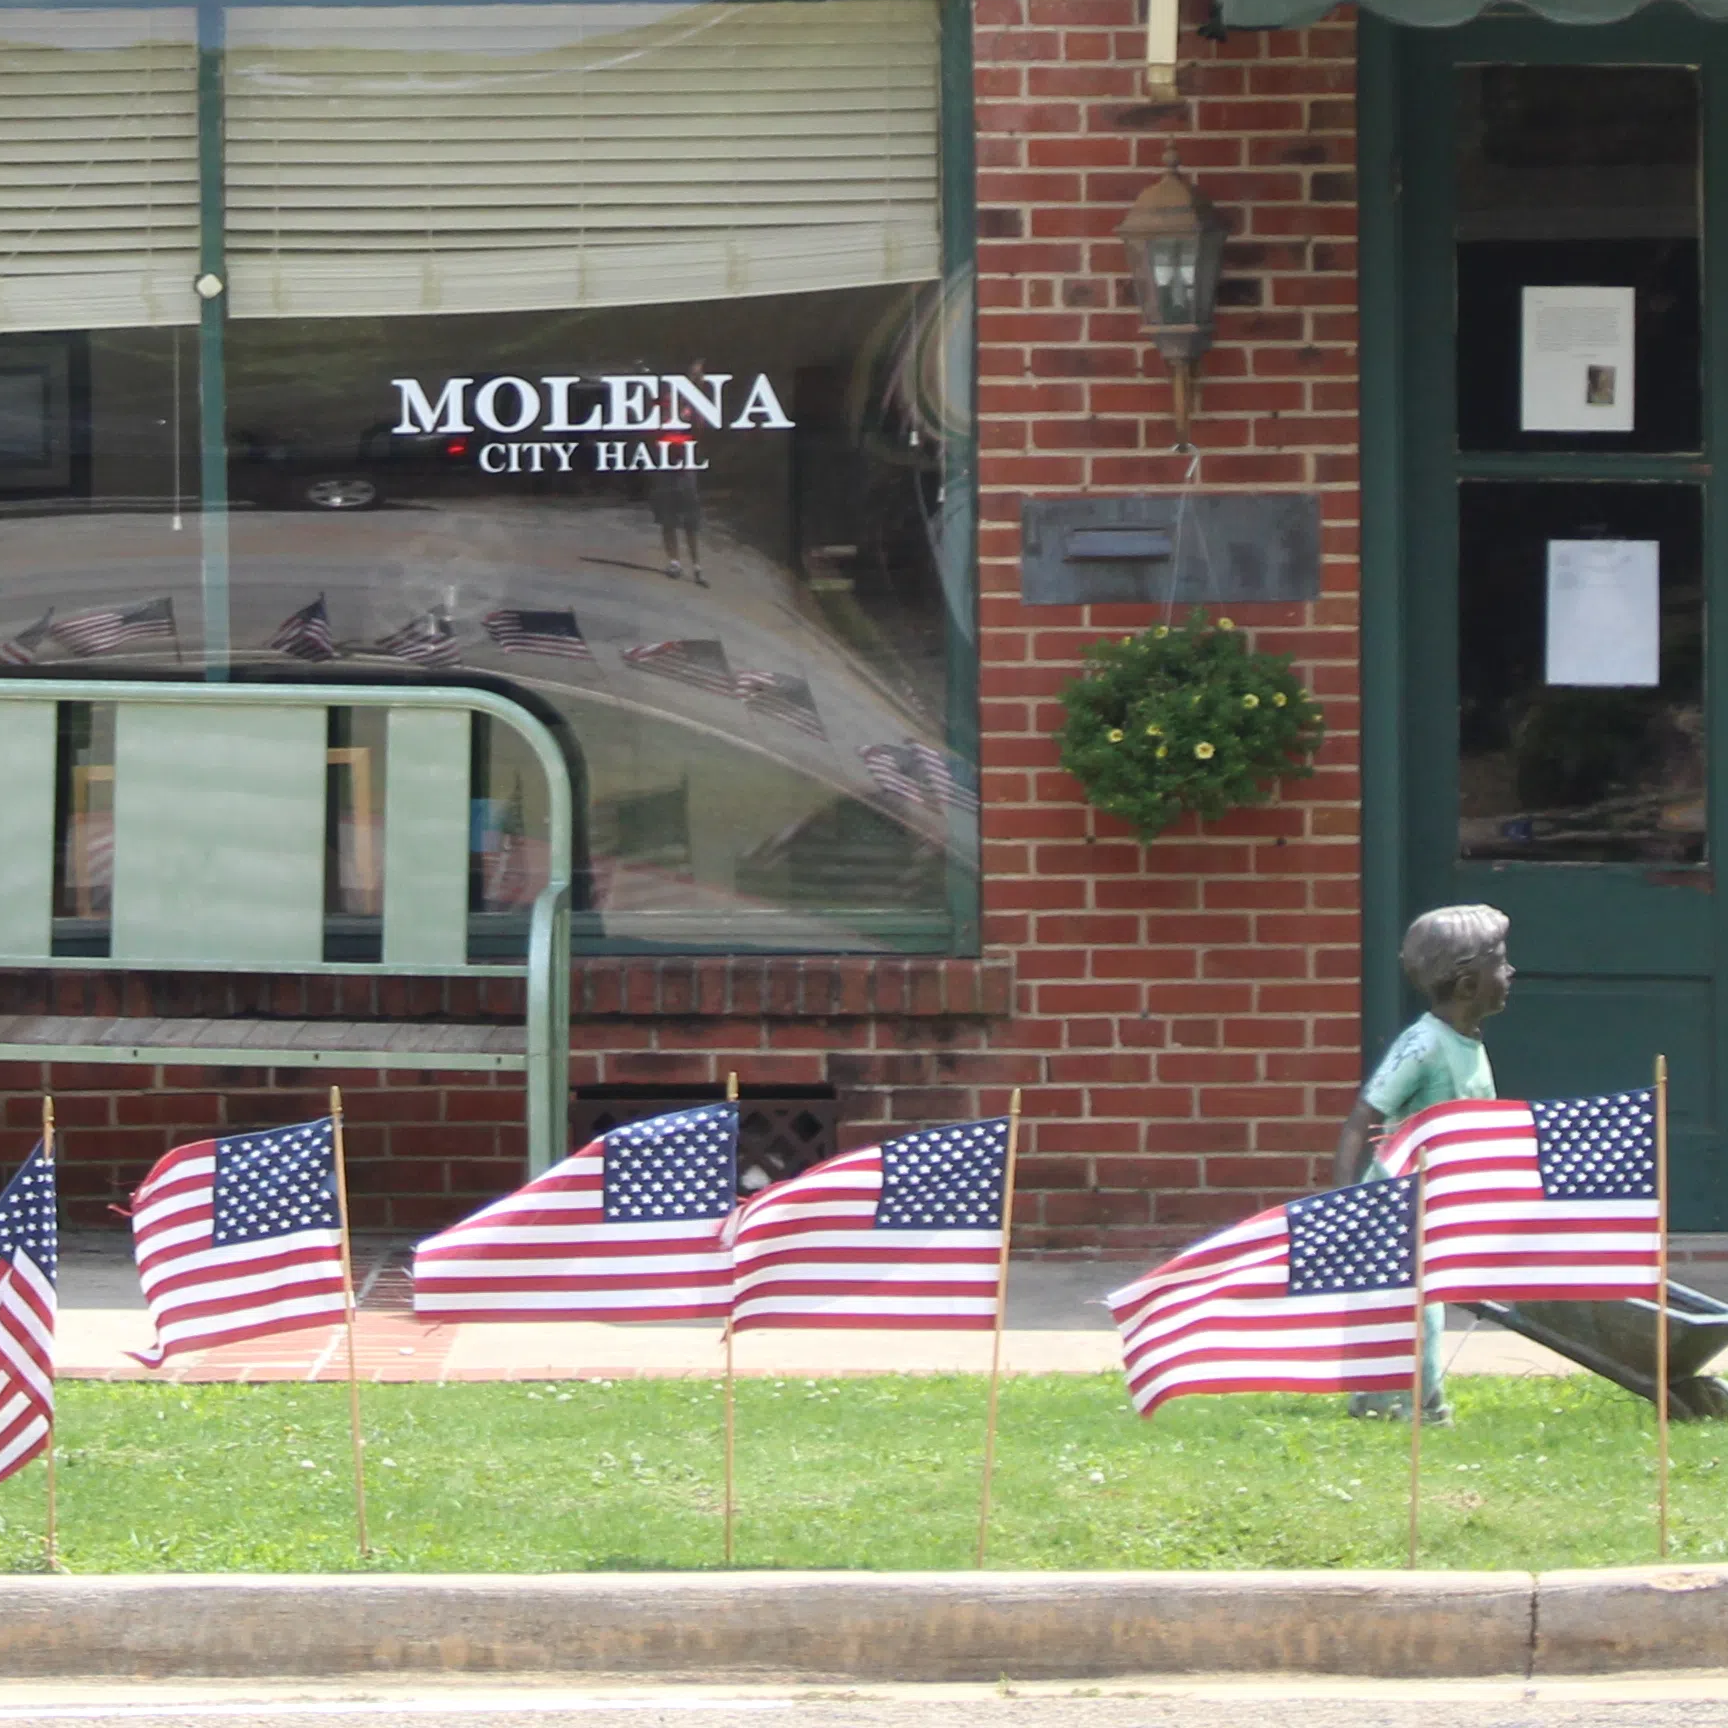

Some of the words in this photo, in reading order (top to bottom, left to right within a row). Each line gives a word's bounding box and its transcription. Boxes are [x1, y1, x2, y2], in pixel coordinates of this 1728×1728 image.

[391, 373, 796, 435] MOLENA
[479, 441, 579, 474] CITY
[595, 439, 709, 472] HALL
